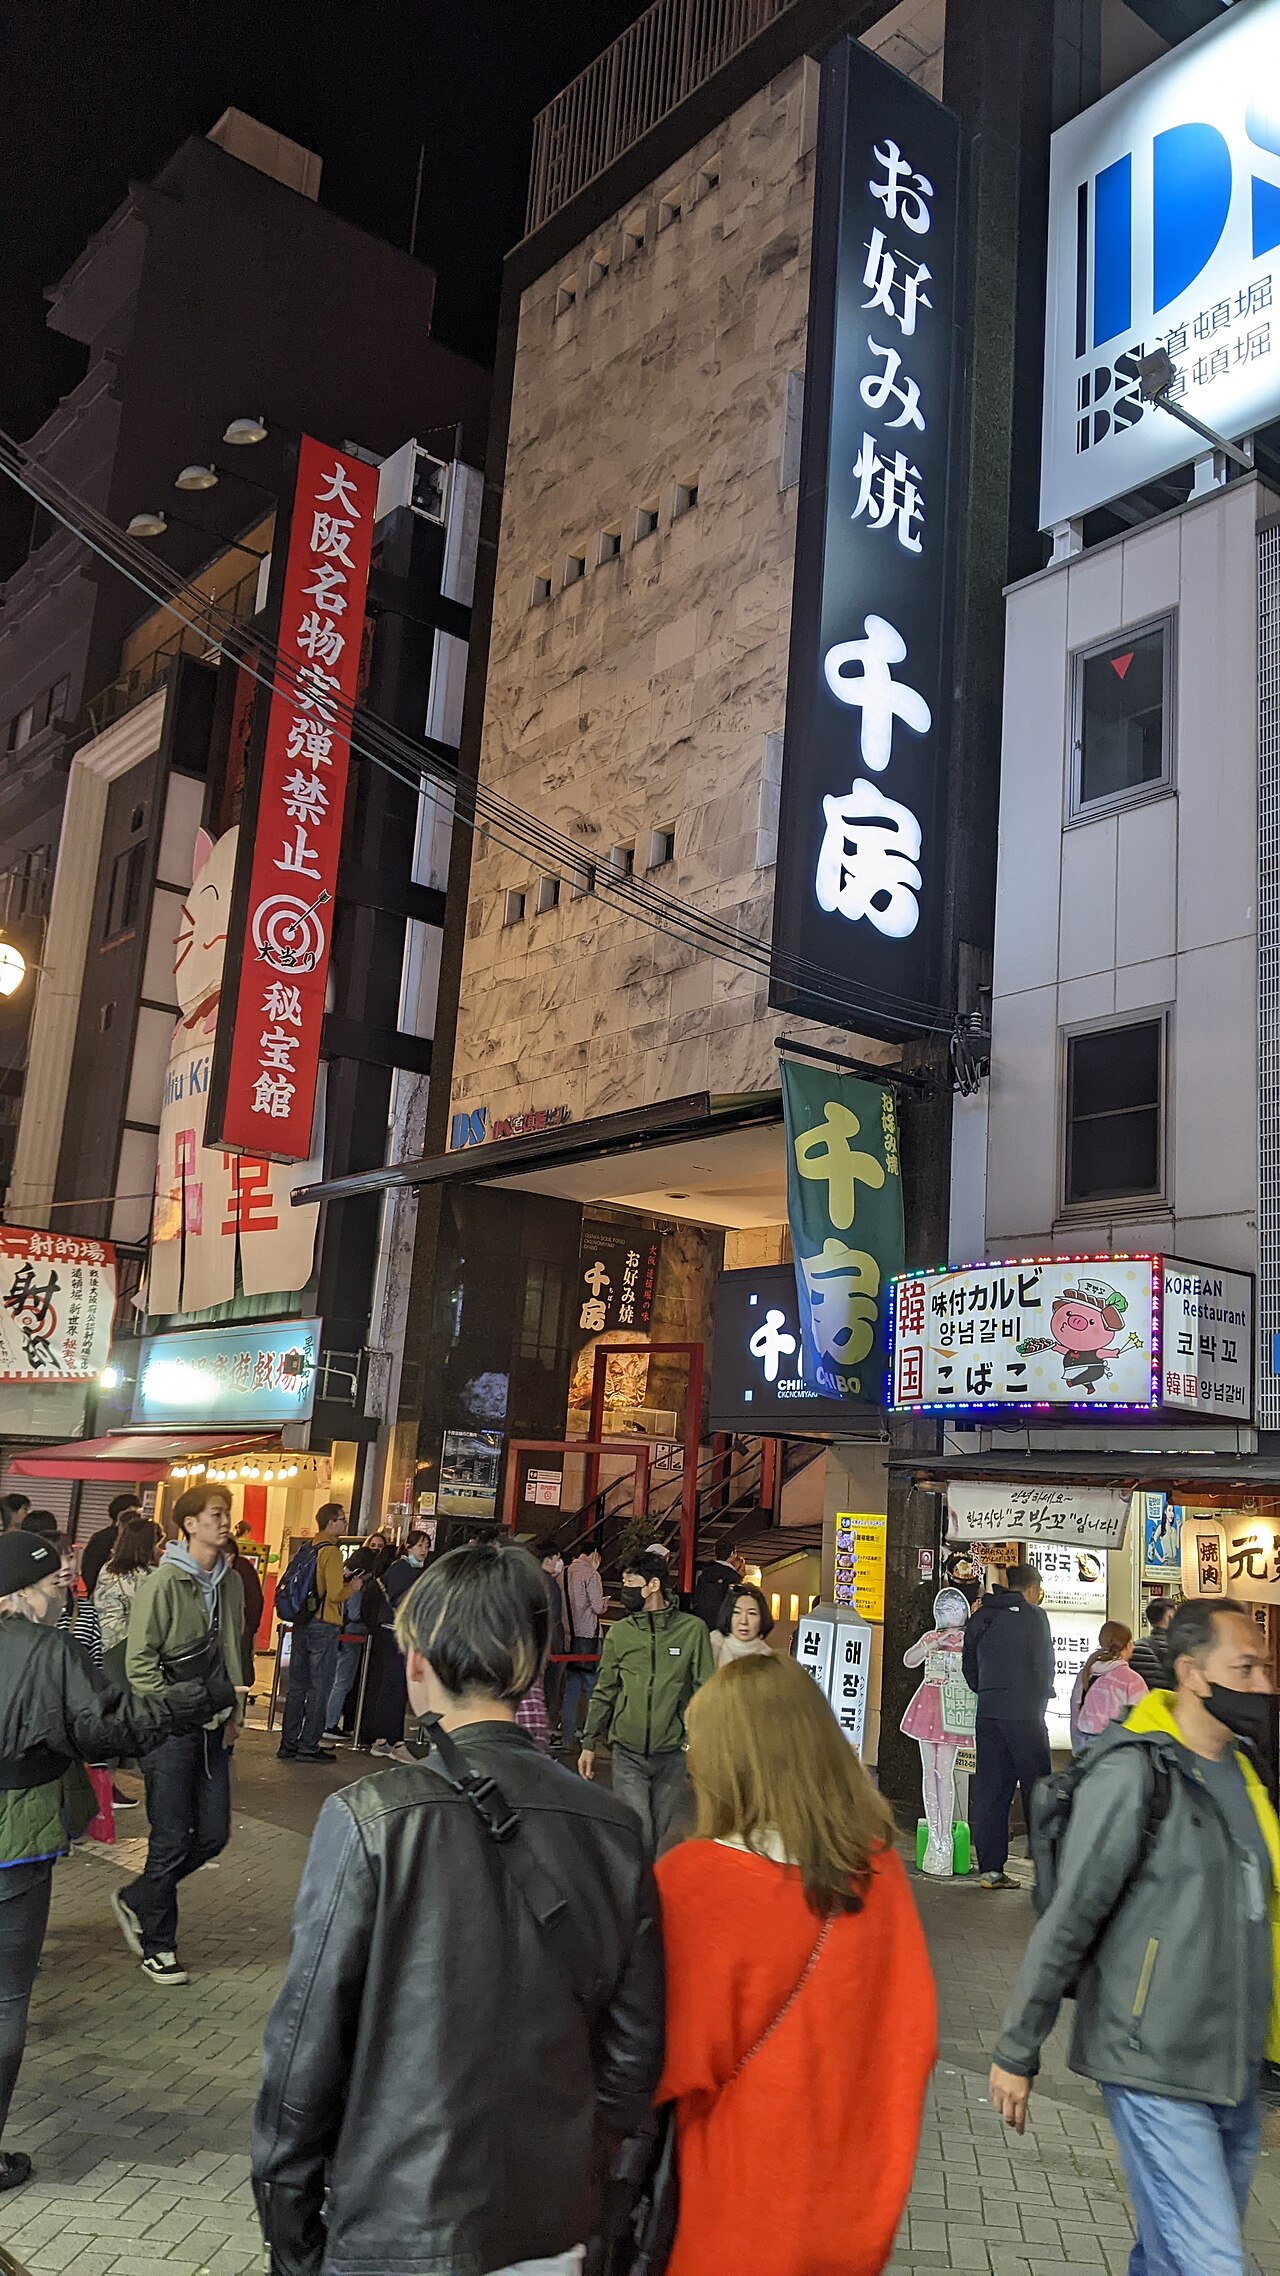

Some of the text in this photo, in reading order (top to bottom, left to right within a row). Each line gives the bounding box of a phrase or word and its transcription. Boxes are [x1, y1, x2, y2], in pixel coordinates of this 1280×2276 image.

[1074, 97, 1280, 360] D
[851, 139, 934, 553] お好み焼
[271, 461, 362, 882] 大阪名物実弾禁止
[816, 614, 932, 938] 千房
[256, 941, 316, 972] 大当り
[250, 980, 303, 1118] 秘宝館
[450, 1106, 487, 1150] DS
[881, 1092, 899, 1176] お好み焼
[794, 1101, 886, 1365] 千房
[580, 1261, 611, 1331] 千房
[618, 1250, 640, 1324] お好み焼
[931, 1266, 1043, 1318] 味付カルビ
[1165, 1277, 1223, 1297] KOREAN
[1183, 1299, 1246, 1327] Restaurant
[750, 1309, 804, 1383] 千
[898, 1280, 926, 1403] 韓国
[939, 1316, 1021, 1346] 양념갈비
[1177, 1331, 1238, 1364] 코박꼬
[816, 1366, 861, 1393] CHIBO
[937, 1361, 1028, 1396] こばこ
[1166, 1371, 1245, 1405] 韓国 양념갈비
[1029, 1551, 1071, 1573] 해장국
[1200, 1542, 1219, 1585] 焼肉
[840, 1640, 862, 1732] 해장국
